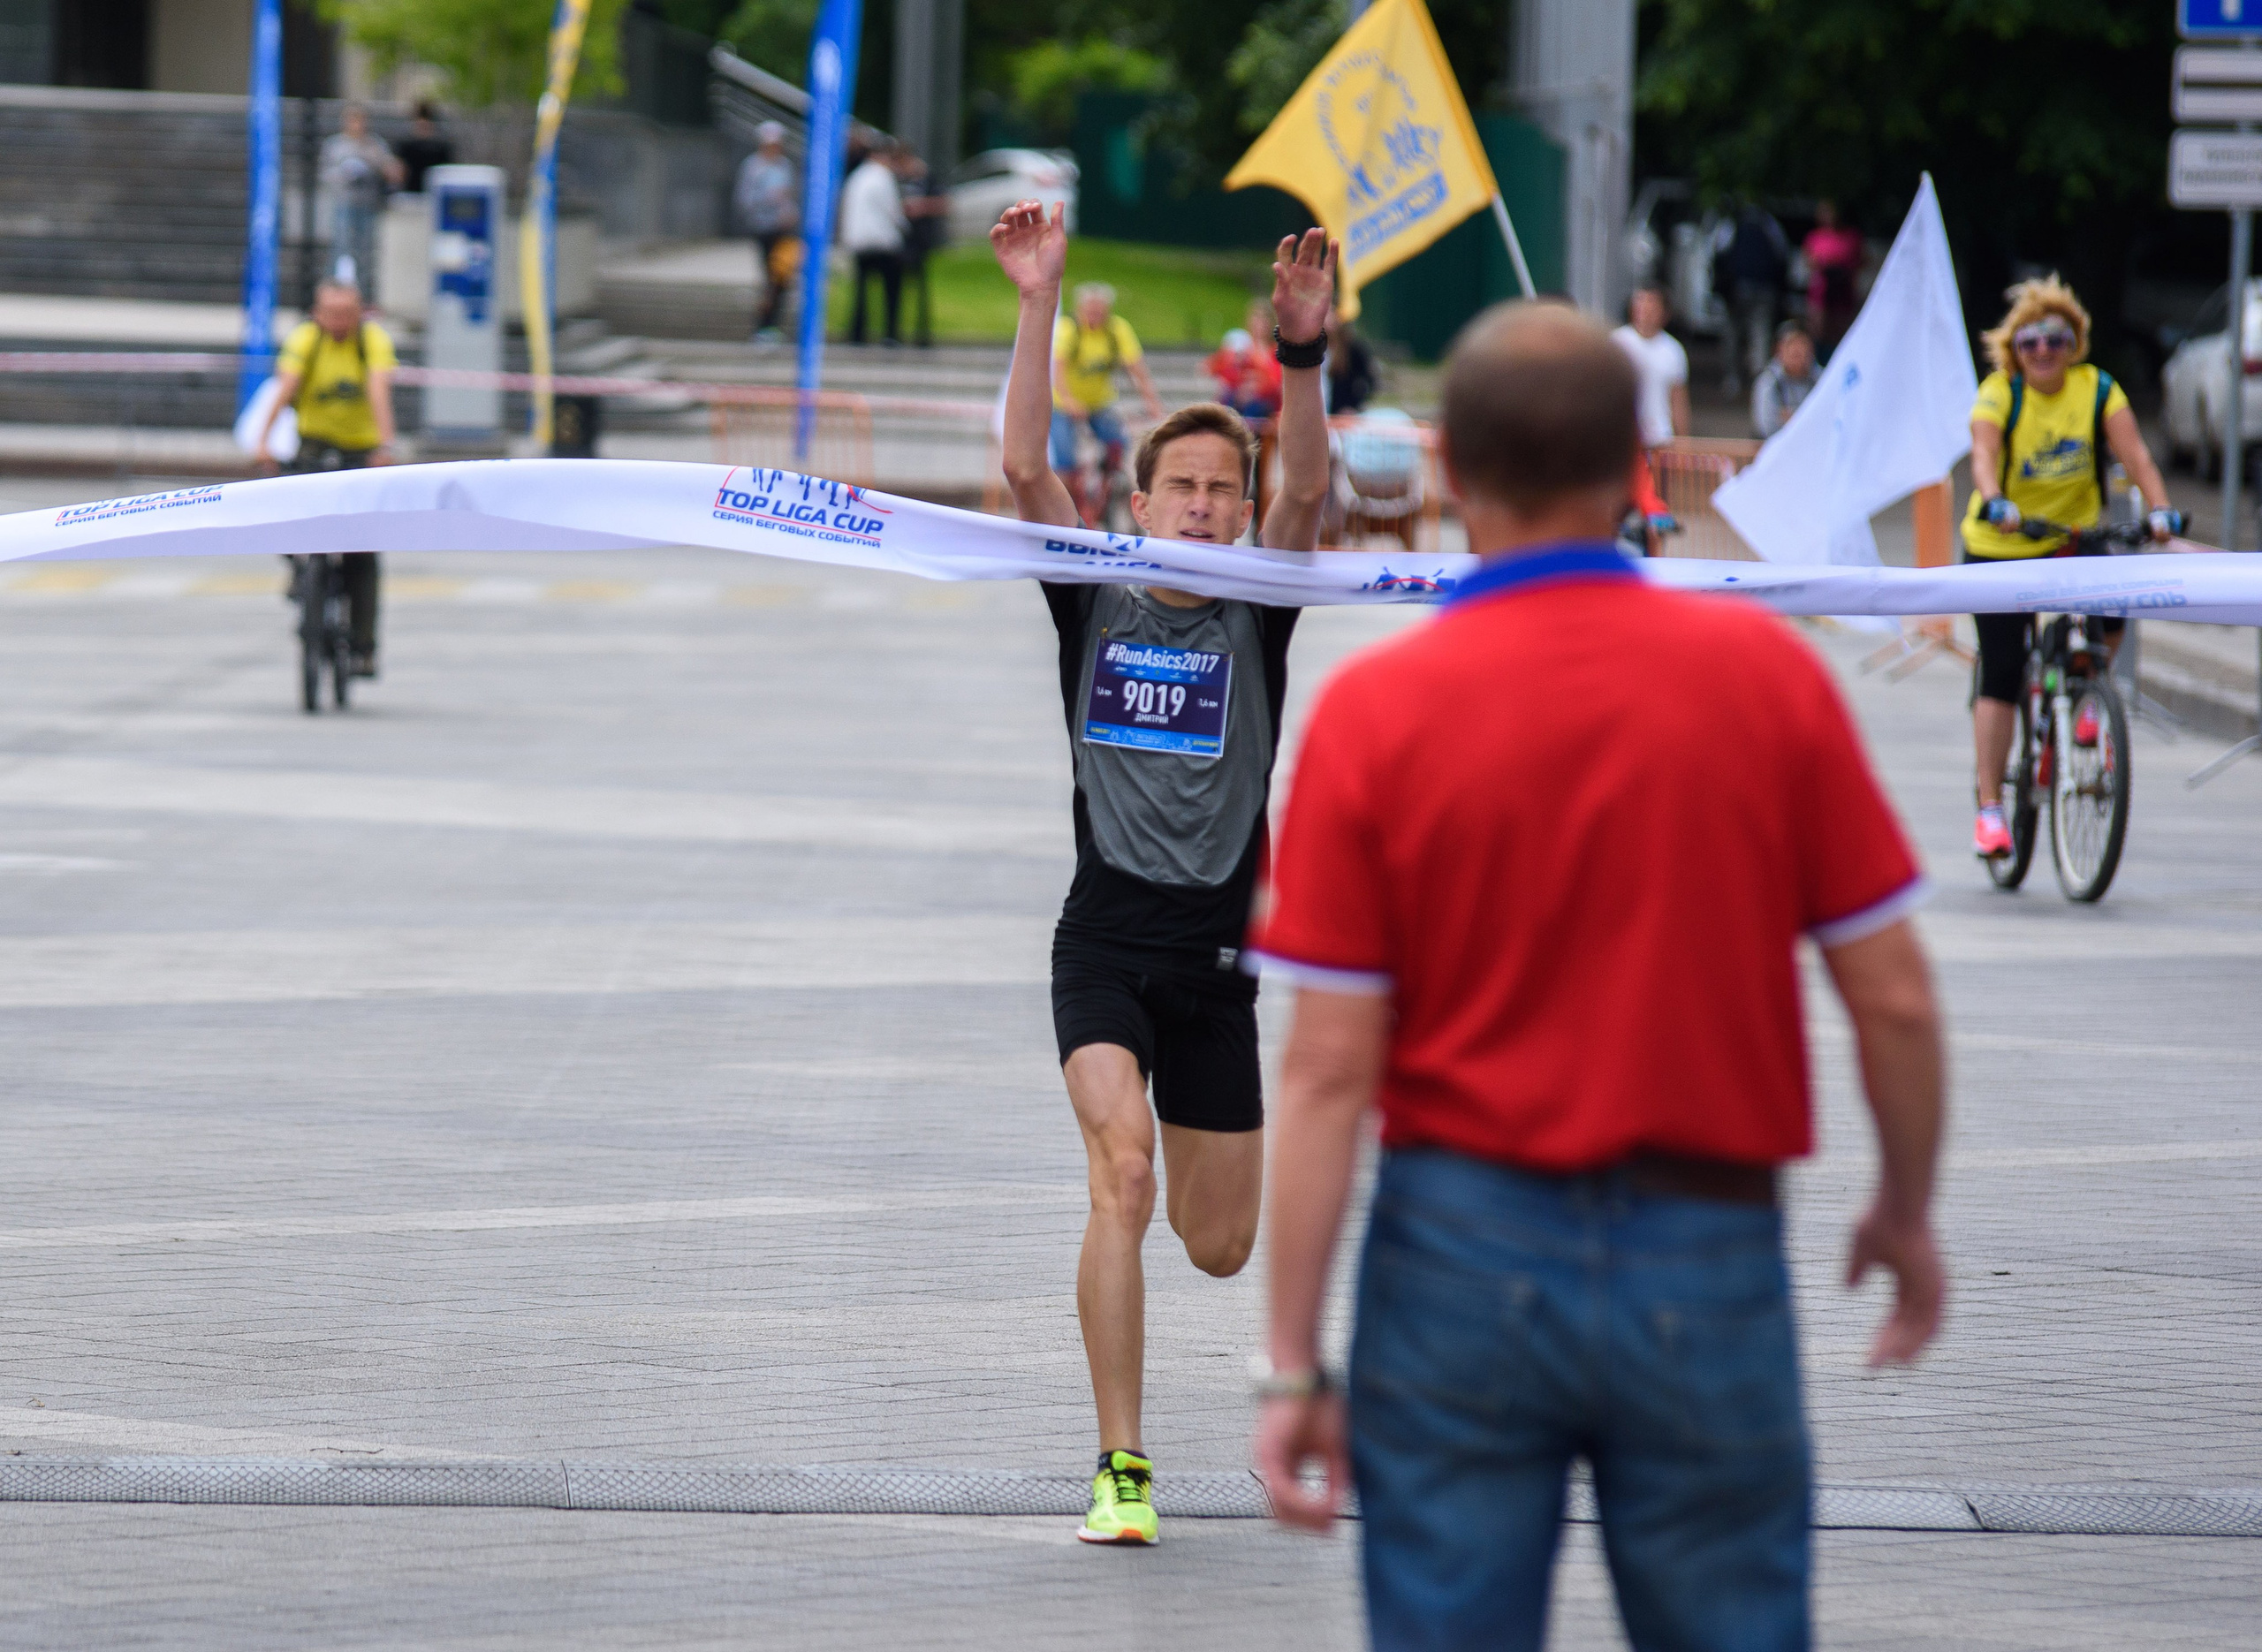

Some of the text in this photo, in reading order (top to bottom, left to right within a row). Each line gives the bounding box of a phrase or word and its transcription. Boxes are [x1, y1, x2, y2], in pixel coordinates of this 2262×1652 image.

[55, 494, 222, 527] СЕРИЯ БЕГОВЫХ СОБЫТИЙ
[719, 488, 884, 534] TOP LIGA CUP
[713, 510, 881, 548] СЕРИЯ БЕГОВЫХ СОБЫТИЙ
[1105, 642, 1219, 674] #RunAsics2017
[1123, 680, 1186, 716] 9019
[1135, 713, 1169, 724] ДМИТРИЙ
